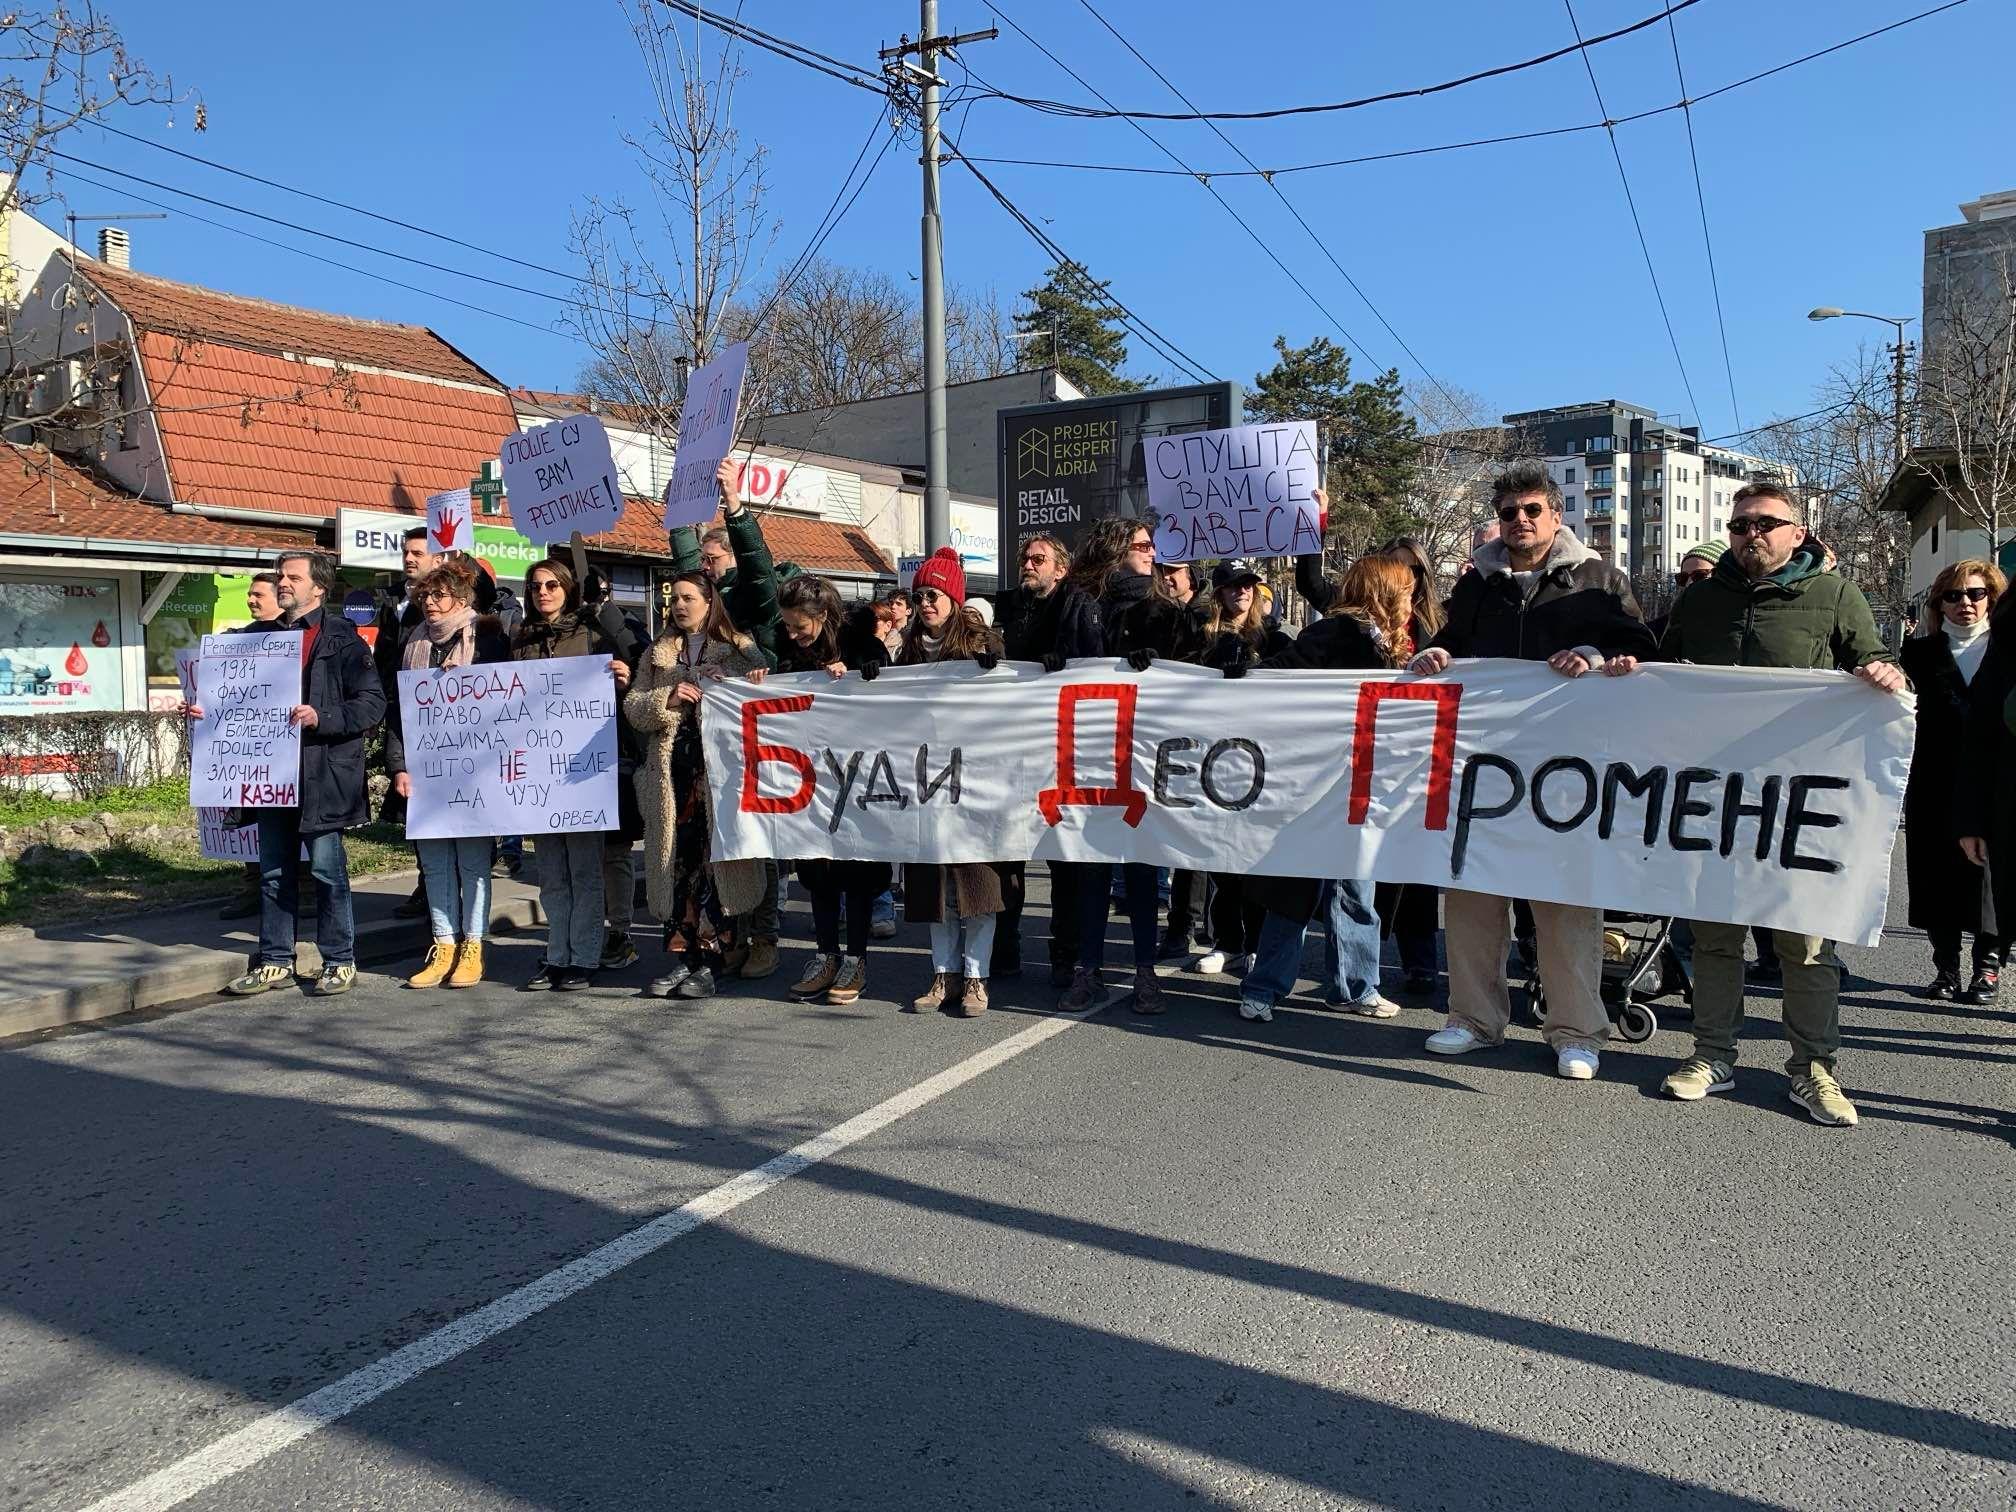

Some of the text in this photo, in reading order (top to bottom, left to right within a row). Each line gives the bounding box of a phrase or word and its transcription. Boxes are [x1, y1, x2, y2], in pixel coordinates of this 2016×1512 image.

[1054, 420, 1118, 441] PROJEKT
[507, 423, 580, 465] ЛОШЕ СУ
[1054, 438, 1117, 459] EKSPERT
[1156, 428, 1318, 480] СПУШТА
[534, 456, 574, 492] ВАМ
[1054, 459, 1098, 477] ADRIA
[1018, 488, 1069, 508] RETAIL
[1176, 467, 1310, 510] ВАМ СЕ
[527, 475, 618, 529] РЕПЛИКЕ!
[1018, 504, 1081, 526] DESIGN
[1160, 506, 1322, 561] ЗАВЕСА
[219, 659, 257, 679] 1984
[217, 682, 272, 707] ФАУСТ
[539, 672, 564, 696] ЈЕ
[417, 699, 616, 727] ПРАВО ДА КАЖЕШ
[225, 723, 297, 739] БОЛЕСНИК
[417, 728, 563, 752] ЉУДИМА ОНО
[210, 740, 273, 765] ПРОЦЕС
[207, 763, 270, 783] ЗЛОЧИН
[424, 749, 610, 783] ШТО НЕ ЖЕЛЕ
[222, 782, 297, 807] И КАЗНА
[447, 787, 485, 809] ДА
[549, 808, 608, 829] ОРВЕЛ
